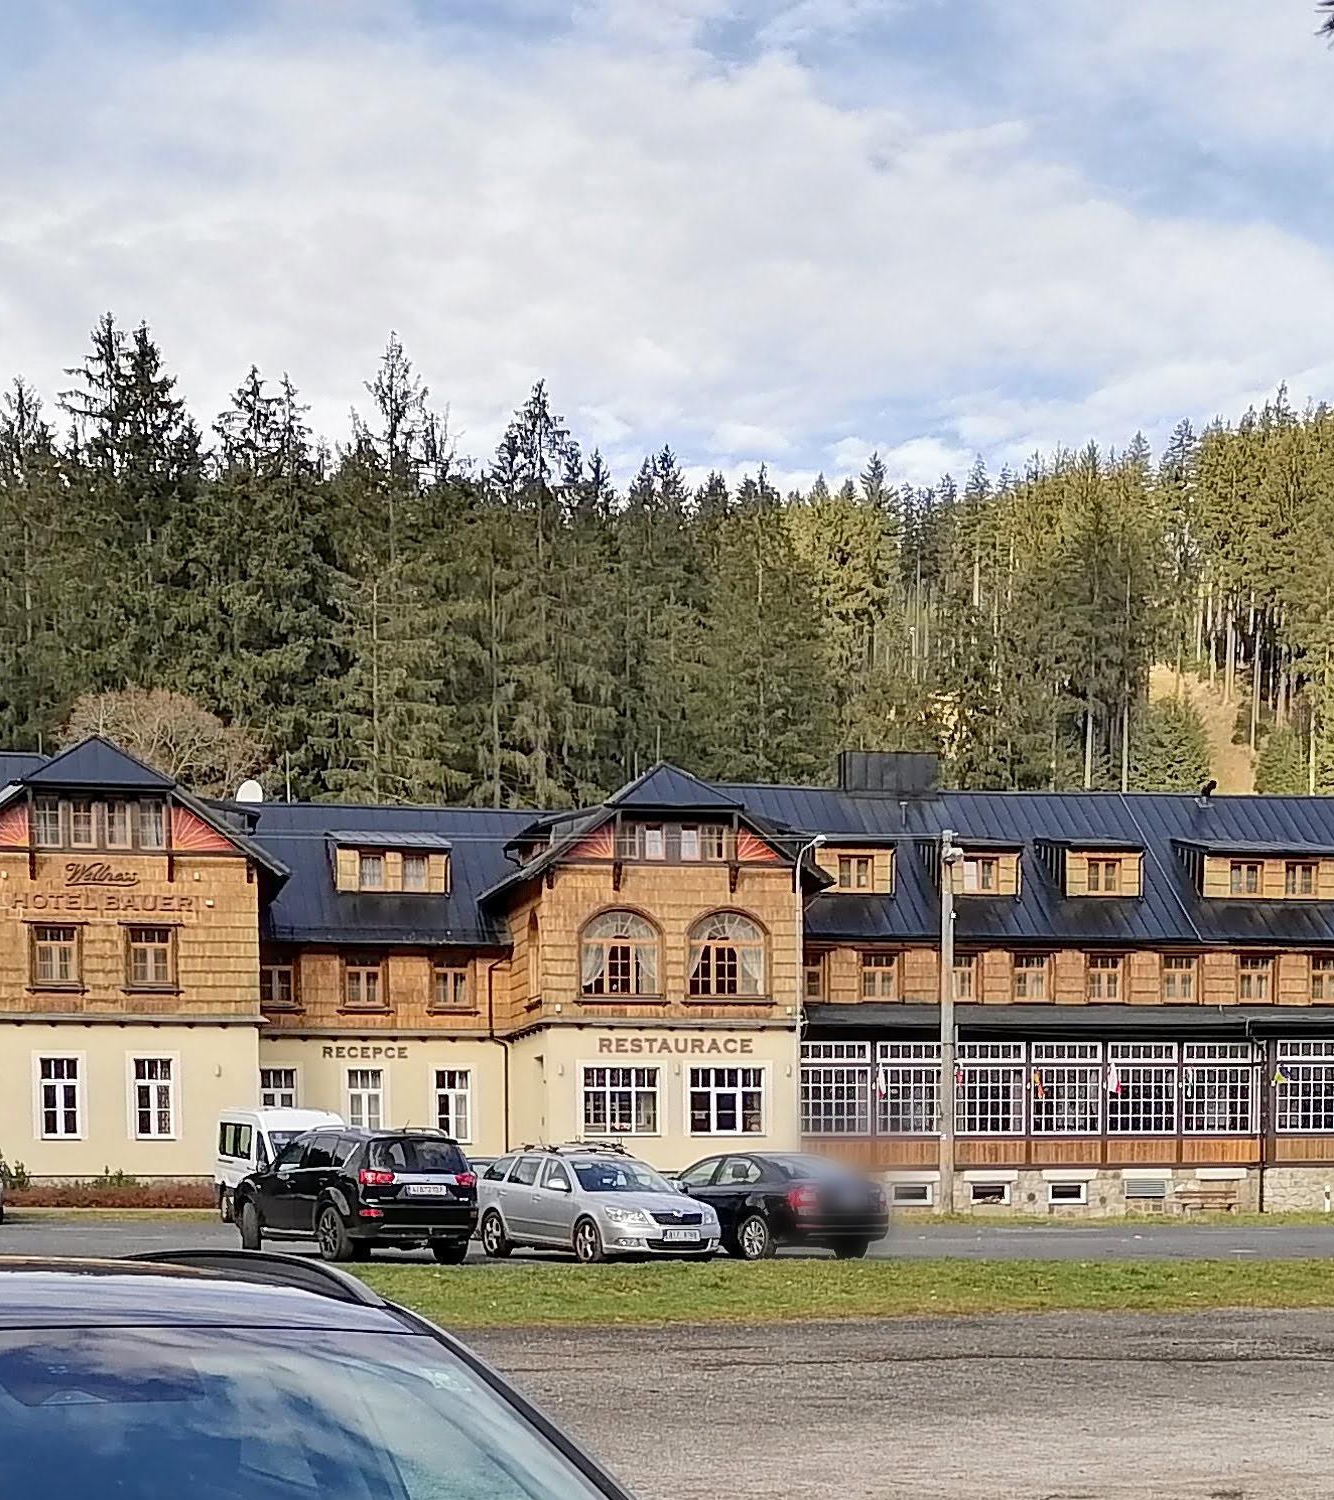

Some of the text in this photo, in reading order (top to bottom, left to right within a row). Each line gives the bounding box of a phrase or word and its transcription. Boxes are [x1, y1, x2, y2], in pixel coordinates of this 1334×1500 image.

[65, 862, 140, 884] Wellness
[11, 893, 194, 912] HOTEL BAUER
[322, 1046, 409, 1059] RECEPCE
[598, 1038, 754, 1054] RESTAURACE
